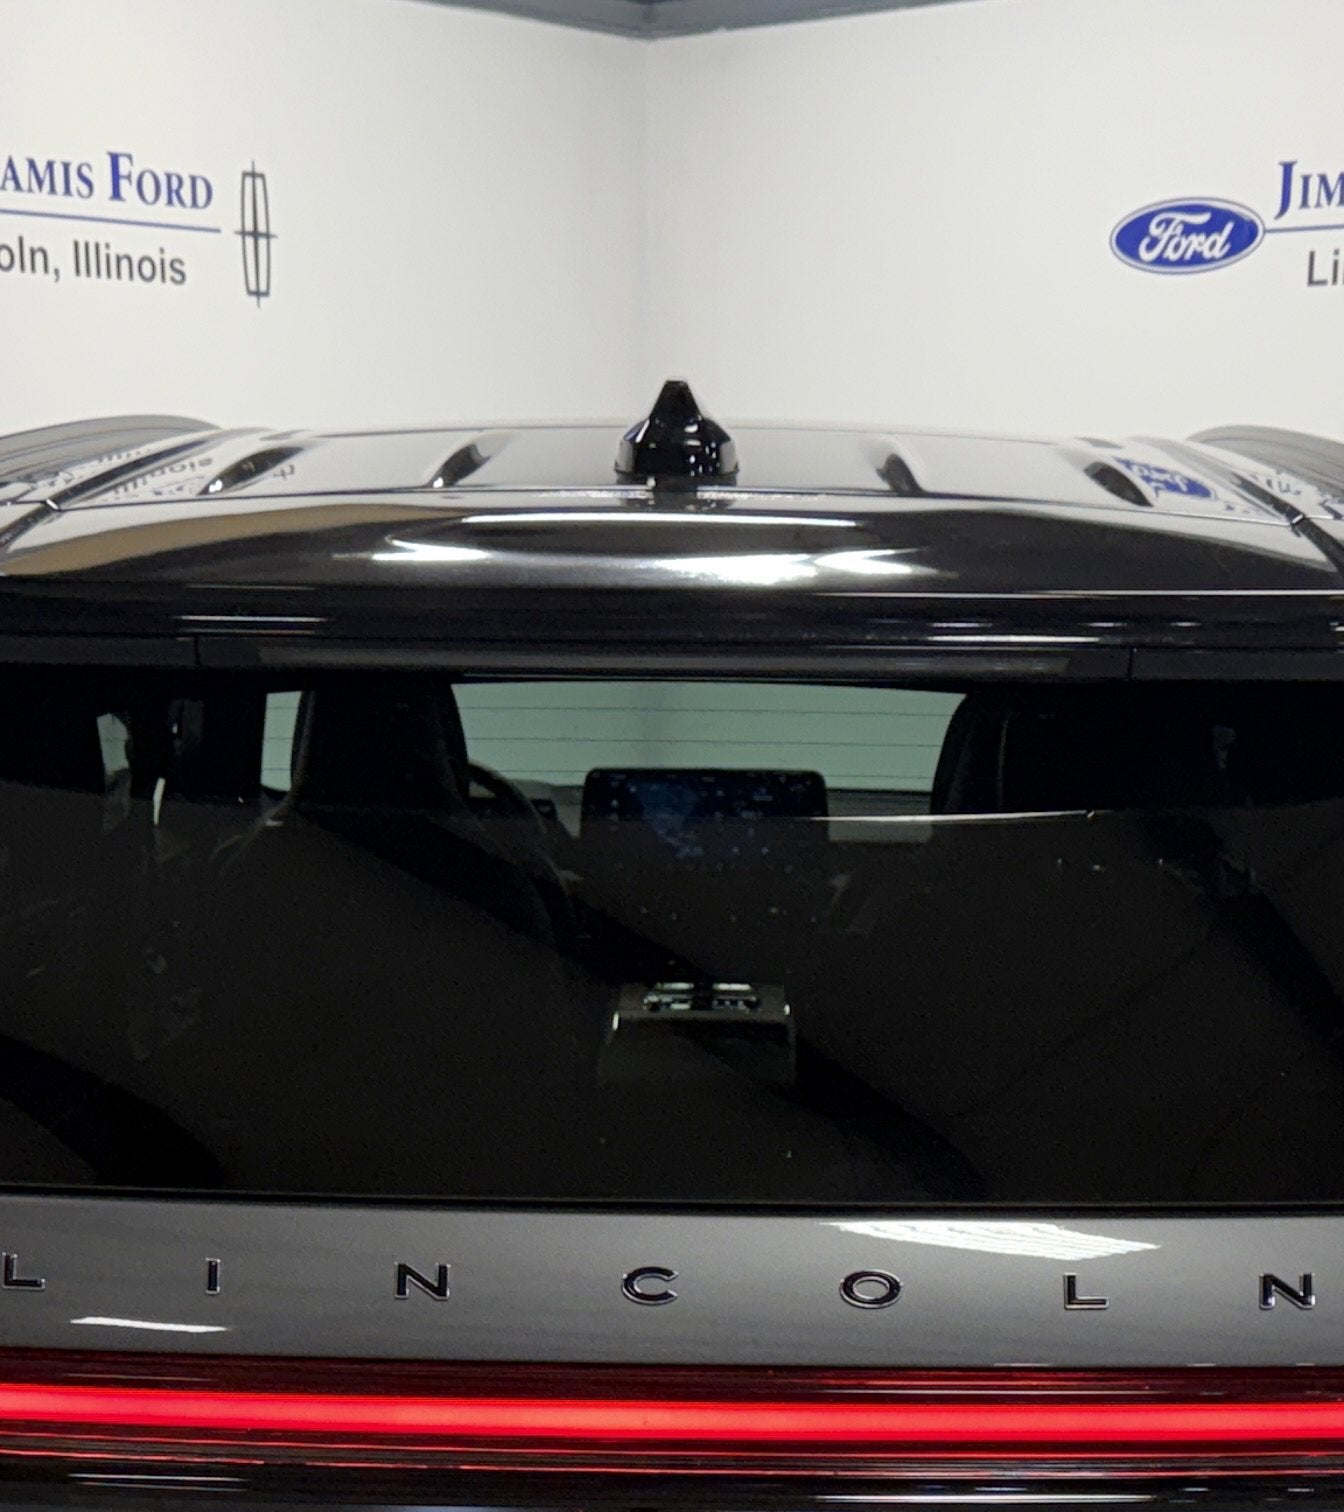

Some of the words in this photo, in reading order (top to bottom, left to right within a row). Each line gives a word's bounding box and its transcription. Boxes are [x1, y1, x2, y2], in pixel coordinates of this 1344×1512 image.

[106, 151, 214, 210] FORD
[73, 239, 187, 286] Illinois
[1138, 211, 1232, 262] Ford
[1, 1251, 1318, 1311] LINCOLN
